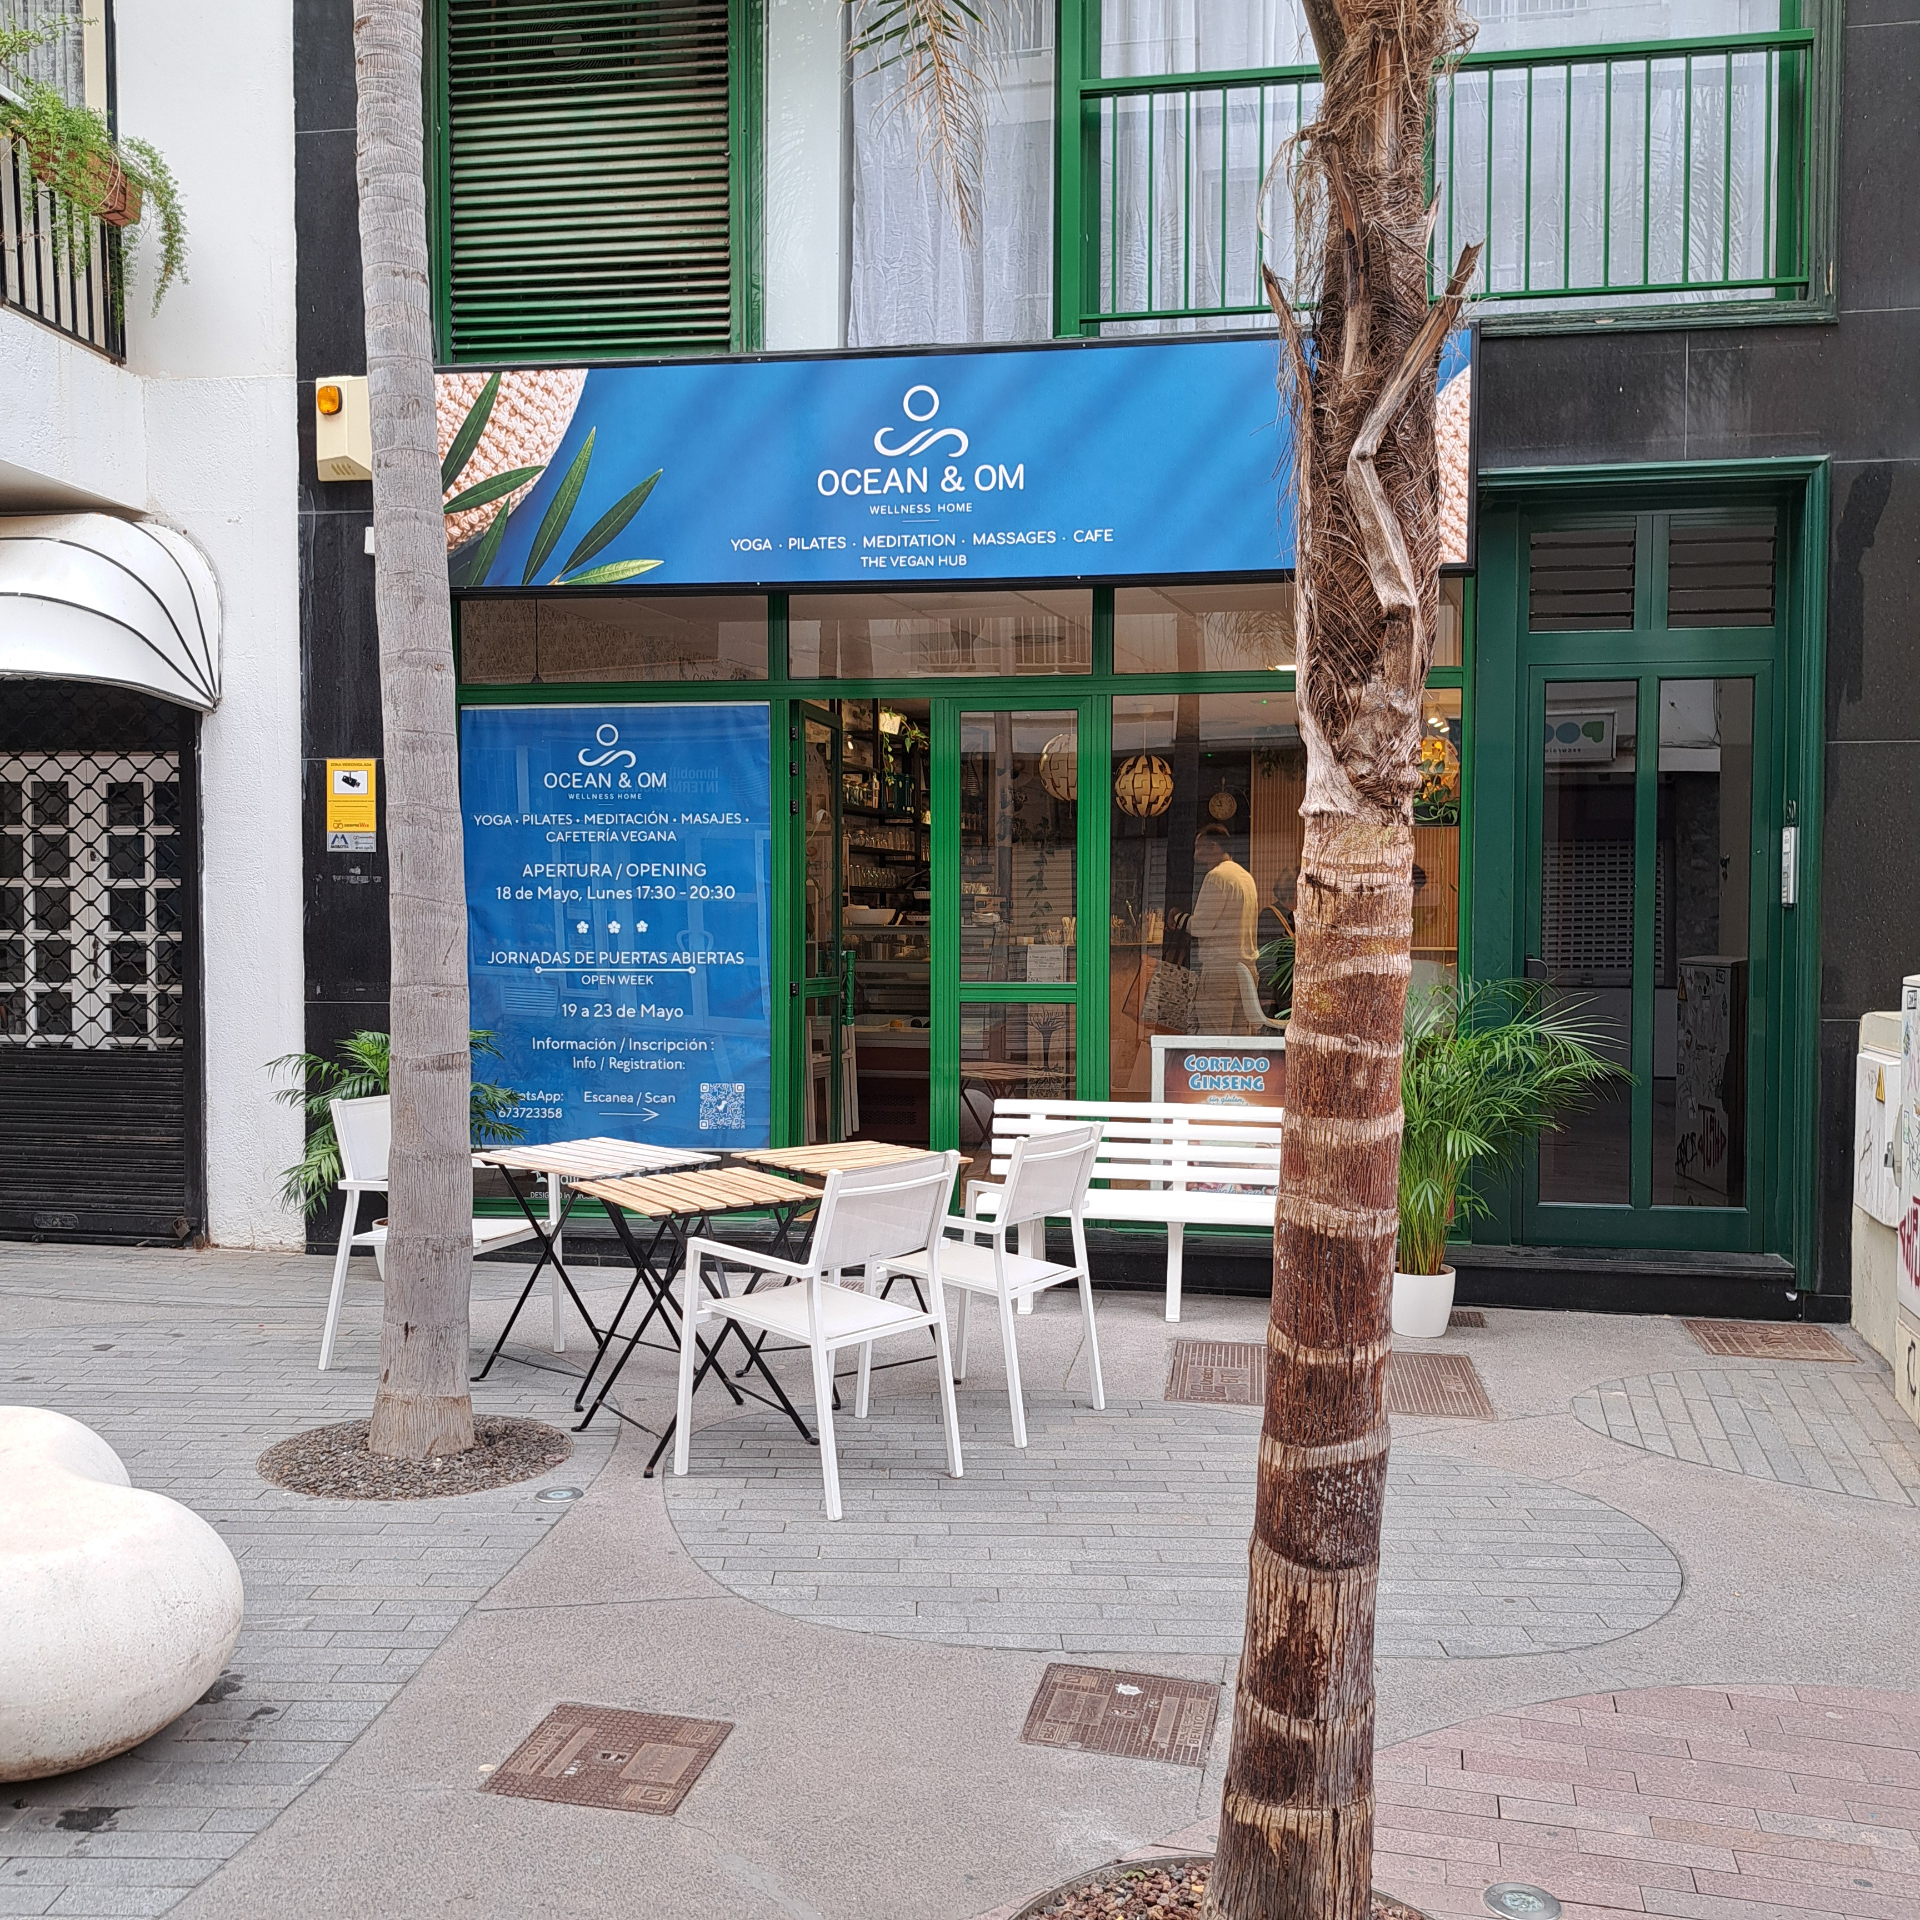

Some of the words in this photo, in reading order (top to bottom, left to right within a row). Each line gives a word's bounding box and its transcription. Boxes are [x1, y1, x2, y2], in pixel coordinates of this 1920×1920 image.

[817, 467, 928, 496] OCEAN
[941, 466, 965, 492] &
[974, 464, 1024, 491] OM
[870, 504, 931, 514] WELLNESS
[938, 503, 972, 512] HOME
[731, 539, 772, 552] YOGA
[788, 537, 846, 550] PILATES
[863, 534, 956, 548] MEDITATION
[973, 531, 1056, 546] MASSAGES
[1073, 529, 1113, 542] CAFE
[861, 557, 887, 567] THE
[890, 556, 934, 567] VEGAN
[939, 555, 967, 566] HUB
[544, 773, 611, 788] OCEAN
[619, 773, 632, 788] &
[638, 773, 666, 788] OM
[474, 815, 513, 826] YOGA
[522, 815, 572, 825] PILATES
[584, 811, 669, 825] MEDITACIÓN
[682, 813, 741, 824] MASAJES
[546, 830, 619, 842] CAFETERÍA
[621, 831, 676, 842] VEGANA
[522, 864, 612, 877] APERTURA
[626, 863, 707, 877] OPENING
[496, 887, 511, 899] 18
[515, 887, 533, 899] de
[538, 886, 582, 903] Mayo,
[587, 887, 633, 899] Lunes
[636, 886, 675, 899] 17:30
[690, 886, 735, 899] 20:30
[488, 952, 571, 965] JORNADAS
[575, 952, 595, 964] DE
[600, 952, 667, 964] PUERTAS
[671, 951, 744, 964] ABIERTAS
[581, 975, 615, 985] OPEN
[618, 975, 654, 985] WEEK
[562, 1004, 577, 1017] 19
[582, 1008, 590, 1017] a
[594, 1004, 612, 1017] 23
[617, 1004, 636, 1017] de
[641, 1004, 683, 1021] Mayo
[532, 1038, 616, 1050] Información
[629, 1038, 707, 1053] Inscripción
[573, 1057, 596, 1069] Info
[609, 1057, 685, 1073] Registration:
[1184, 1054, 1270, 1073] CORTADO
[1189, 1073, 1264, 1091] GINSENG
[584, 1092, 634, 1104] Escanea
[645, 1092, 675, 1104] Scan
[1188, 1715, 1206, 1744] BENITO
[527, 1724, 562, 1756] BENITO
